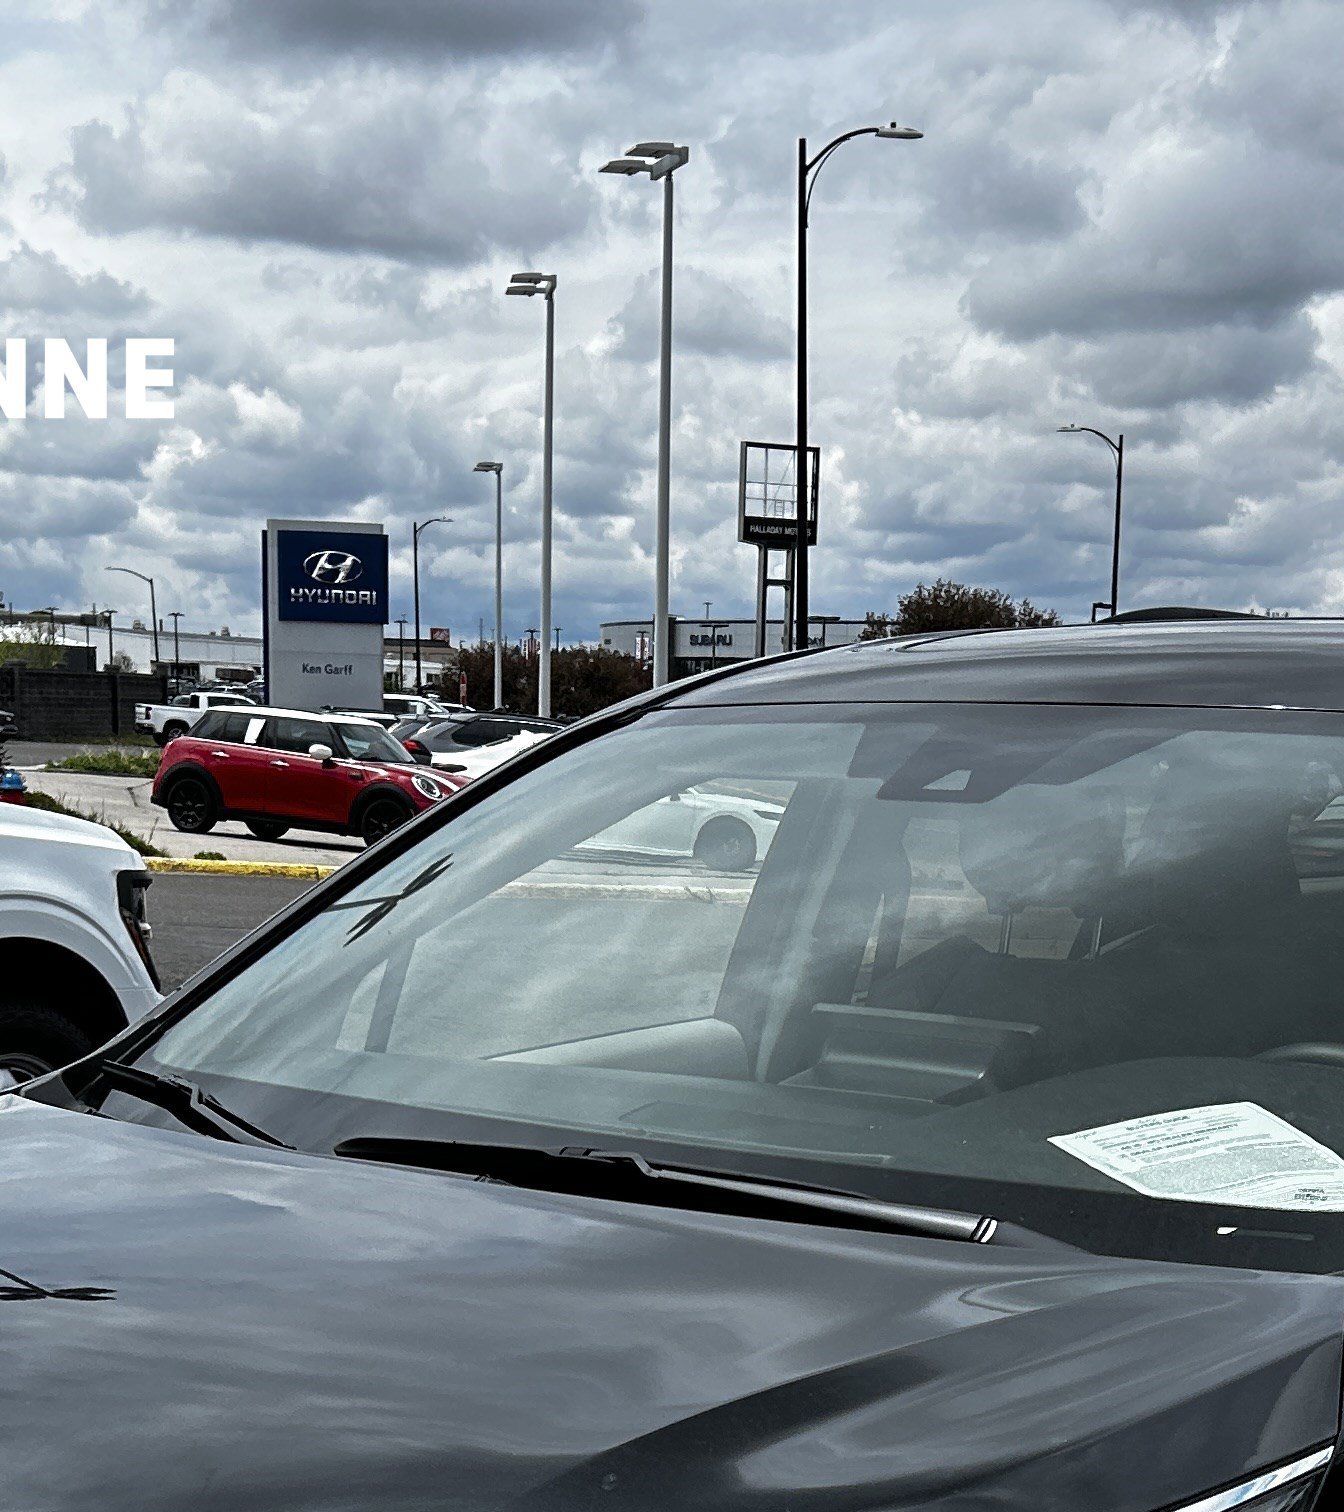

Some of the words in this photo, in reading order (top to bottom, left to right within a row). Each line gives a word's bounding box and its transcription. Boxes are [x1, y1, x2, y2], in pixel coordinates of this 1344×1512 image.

[290, 587, 378, 606] HYUNDAI
[689, 634, 733, 647] SUBARU
[302, 663, 322, 674] Ken
[324, 664, 353, 676] Garff
